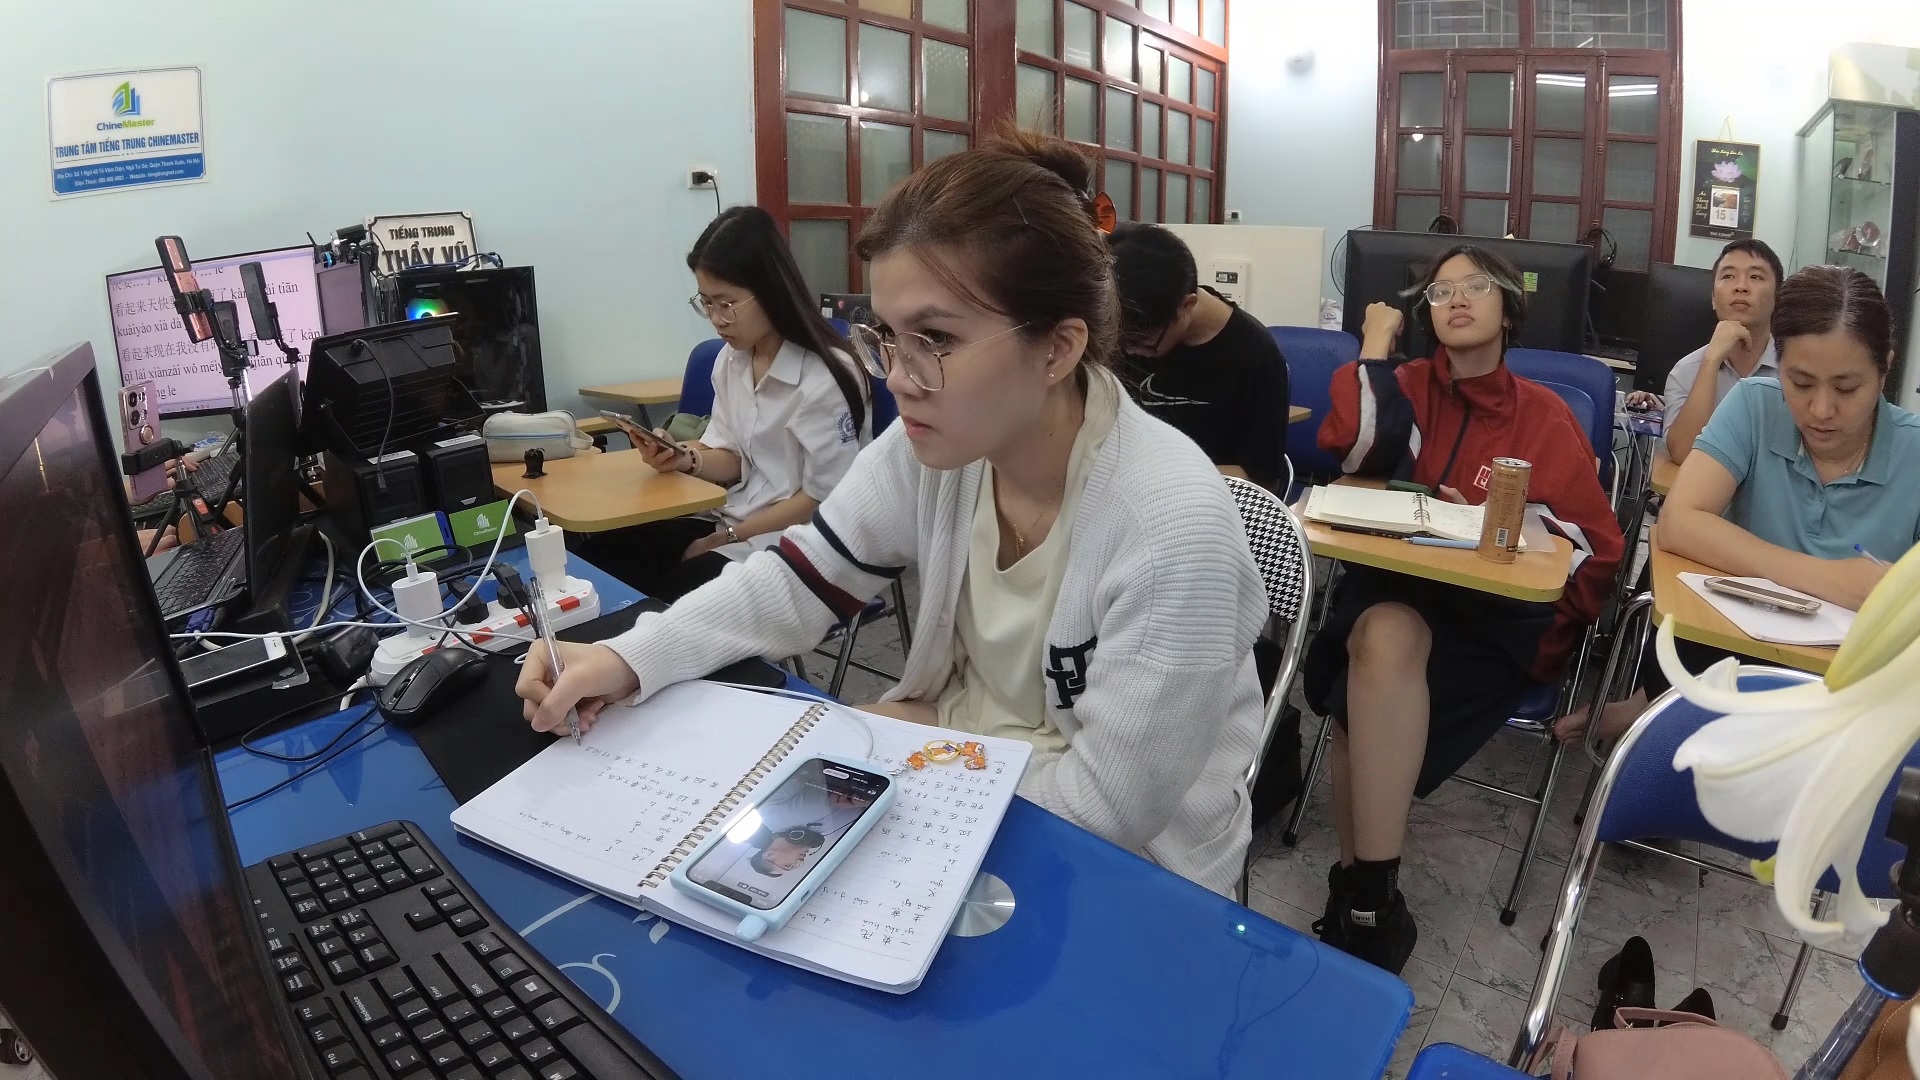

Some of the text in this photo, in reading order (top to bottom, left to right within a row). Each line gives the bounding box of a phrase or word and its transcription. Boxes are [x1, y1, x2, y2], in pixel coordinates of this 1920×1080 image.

[96, 119, 155, 131] ChineMaster
[55, 132, 199, 158] TRUNG TÂM TIẾNG TRUNG CHINEMASTER
[1716, 210, 1726, 220] 15
[388, 225, 455, 240] TIẾNG TRUNG
[382, 241, 469, 272] THẦY VŨ
[279, 282, 298, 294] tiān
[154, 320, 168, 332] xià
[168, 385, 176, 396] le
[303, 1007, 312, 1018] F12
[354, 996, 372, 1022] Backspace
[328, 1053, 338, 1064] F10
